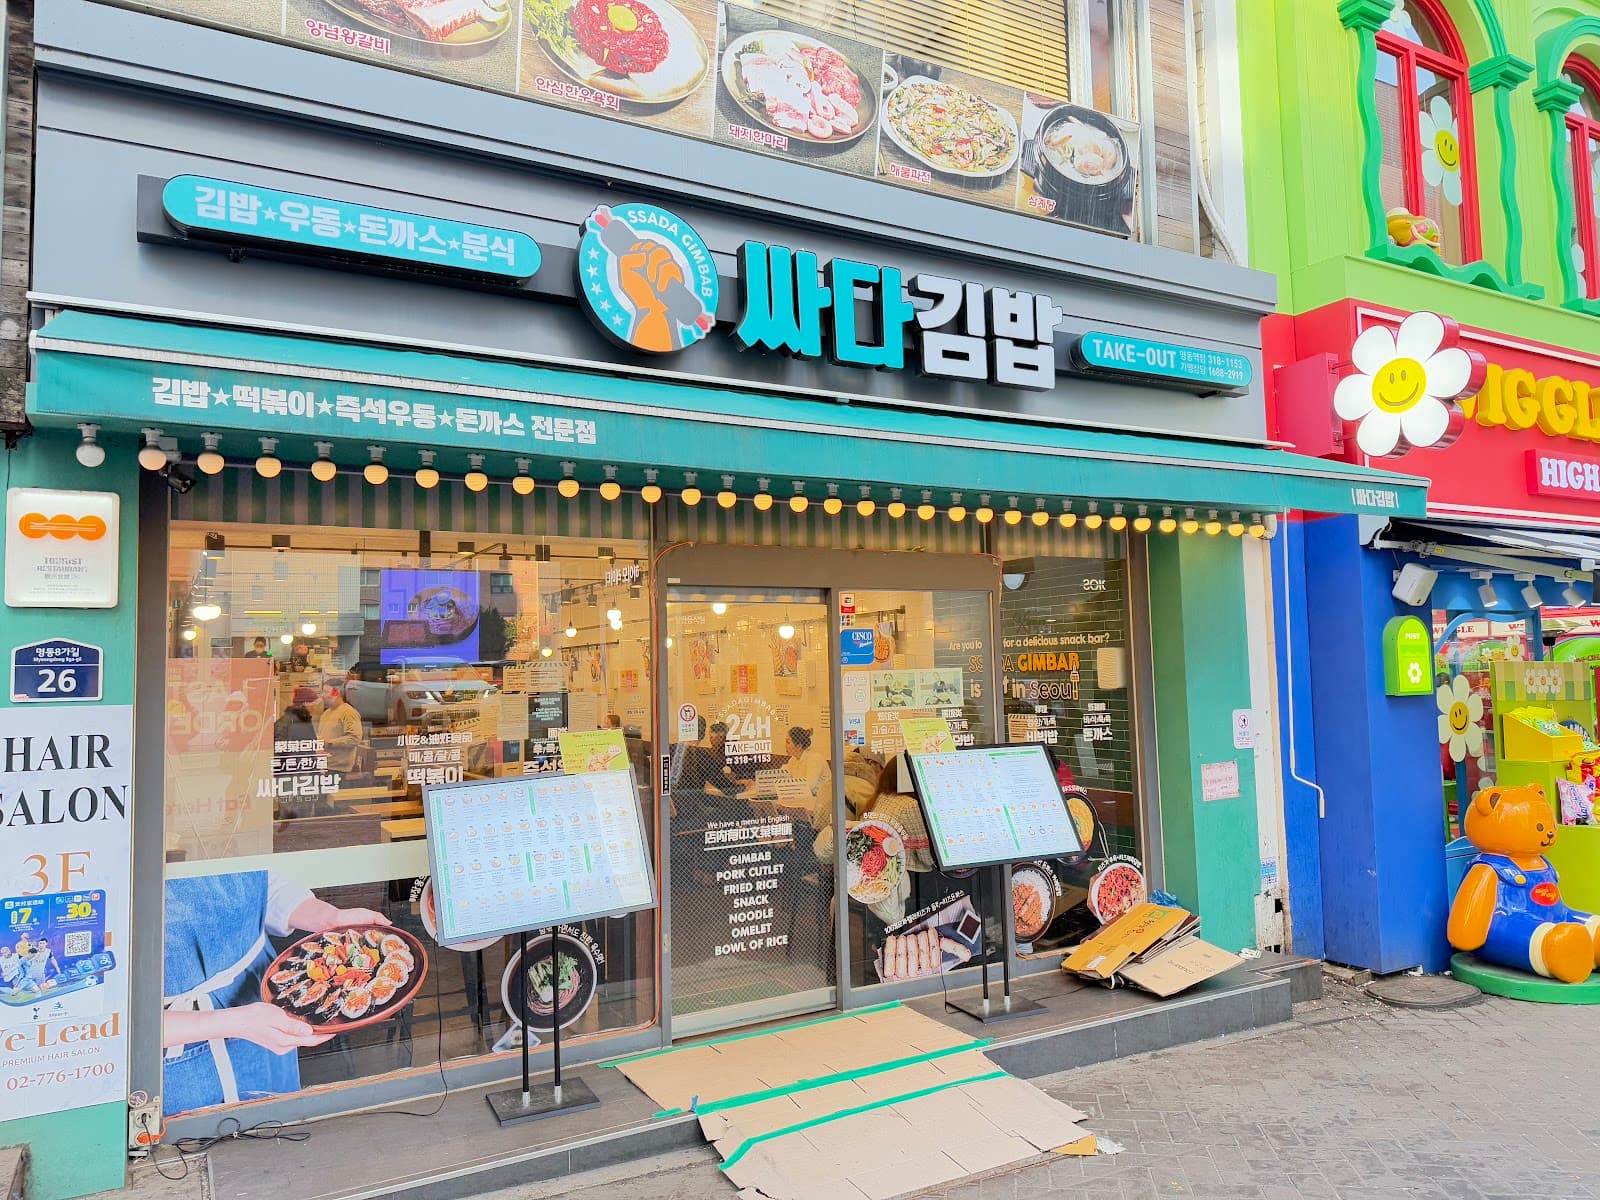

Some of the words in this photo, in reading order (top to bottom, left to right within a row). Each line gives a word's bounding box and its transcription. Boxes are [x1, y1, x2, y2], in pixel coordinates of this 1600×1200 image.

[305, 19, 391, 55] 양념왕갈비
[535, 77, 621, 110] 안심한우육회
[727, 123, 788, 150] 돼지한마리
[889, 162, 932, 185] 해물파전
[194, 183, 263, 226] 김밥
[277, 202, 343, 240] 우동
[358, 214, 448, 258] 돈까스
[461, 230, 516, 268] 분식
[627, 209, 680, 236] SSADA
[1092, 339, 1177, 370] TAKE-OUT
[1207, 354, 1243, 372] 318-1153
[1207, 366, 1244, 384] 1688-2919
[152, 376, 217, 408] 김밥
[233, 385, 315, 419] 떡볶이
[337, 395, 438, 431] 즉석우동
[456, 407, 525, 437] 돈까스
[531, 414, 598, 444] 전문점
[852, 631, 872, 641] CESCO
[961, 640, 975, 652] you
[1003, 637, 1014, 649] for
[1015, 639, 1022, 648] a
[1023, 635, 1059, 648] delicious
[1060, 633, 1086, 646] snack
[1087, 632, 1110, 645] bar?
[37, 669, 77, 693] 26
[970, 678, 982, 699] is
[1011, 678, 1027, 699] in
[724, 713, 772, 741] 24H
[4, 734, 113, 774] HAIR
[727, 742, 771, 755] TAKE-OUT
[734, 754, 772, 765] 318-1153
[256, 773, 342, 798] 싸다김밥
[707, 821, 719, 830] We
[719, 819, 735, 829] have
[760, 816, 767, 825] in
[767, 815, 791, 825] English
[729, 851, 772, 866] GIMBAB
[22, 850, 92, 897] 3F
[716, 868, 746, 882] PORK
[748, 863, 785, 878] CUTLET
[723, 881, 753, 897] FRIED
[756, 878, 778, 891] RICE
[66, 901, 92, 919] 30
[733, 893, 769, 909] SNACK
[728, 908, 774, 925] NOODLE
[731, 923, 773, 938] OMELET
[714, 940, 747, 957] BOWL
[749, 938, 764, 951] OF
[766, 934, 789, 949] RICE
[2, 1055, 45, 1068] PREMIUM
[47, 1051, 69, 1062] HAIR
[71, 1046, 101, 1059] SALON
[6, 1062, 115, 1092] 02-776-1700
